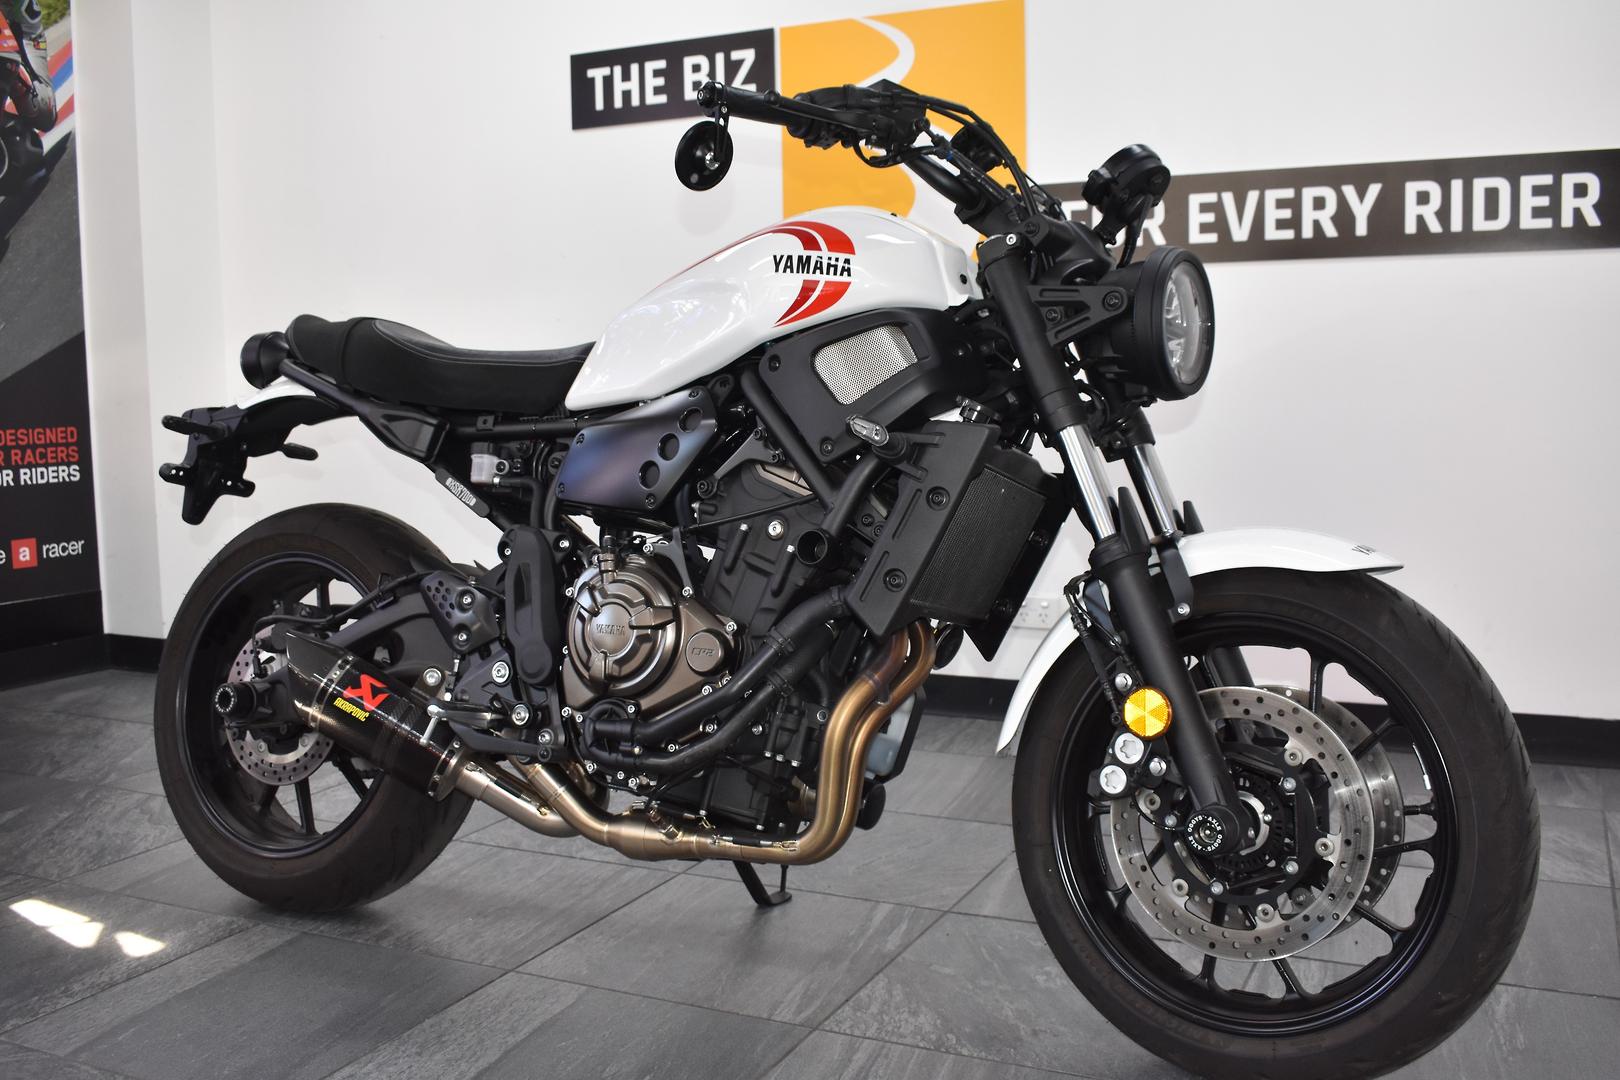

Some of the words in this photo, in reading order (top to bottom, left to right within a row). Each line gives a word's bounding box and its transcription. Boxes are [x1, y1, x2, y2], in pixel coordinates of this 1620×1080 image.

[586, 59, 668, 111] THE
[683, 48, 756, 101] BIZ
[1188, 183, 1382, 244] EVERY
[1405, 172, 1602, 234] RIDER
[773, 254, 852, 277] YAMAHA
[11, 446, 79, 466] RACERS
[0, 469, 14, 487] R
[20, 465, 80, 486] RIDERS
[19, 547, 30, 562] a
[42, 540, 85, 558] racer
